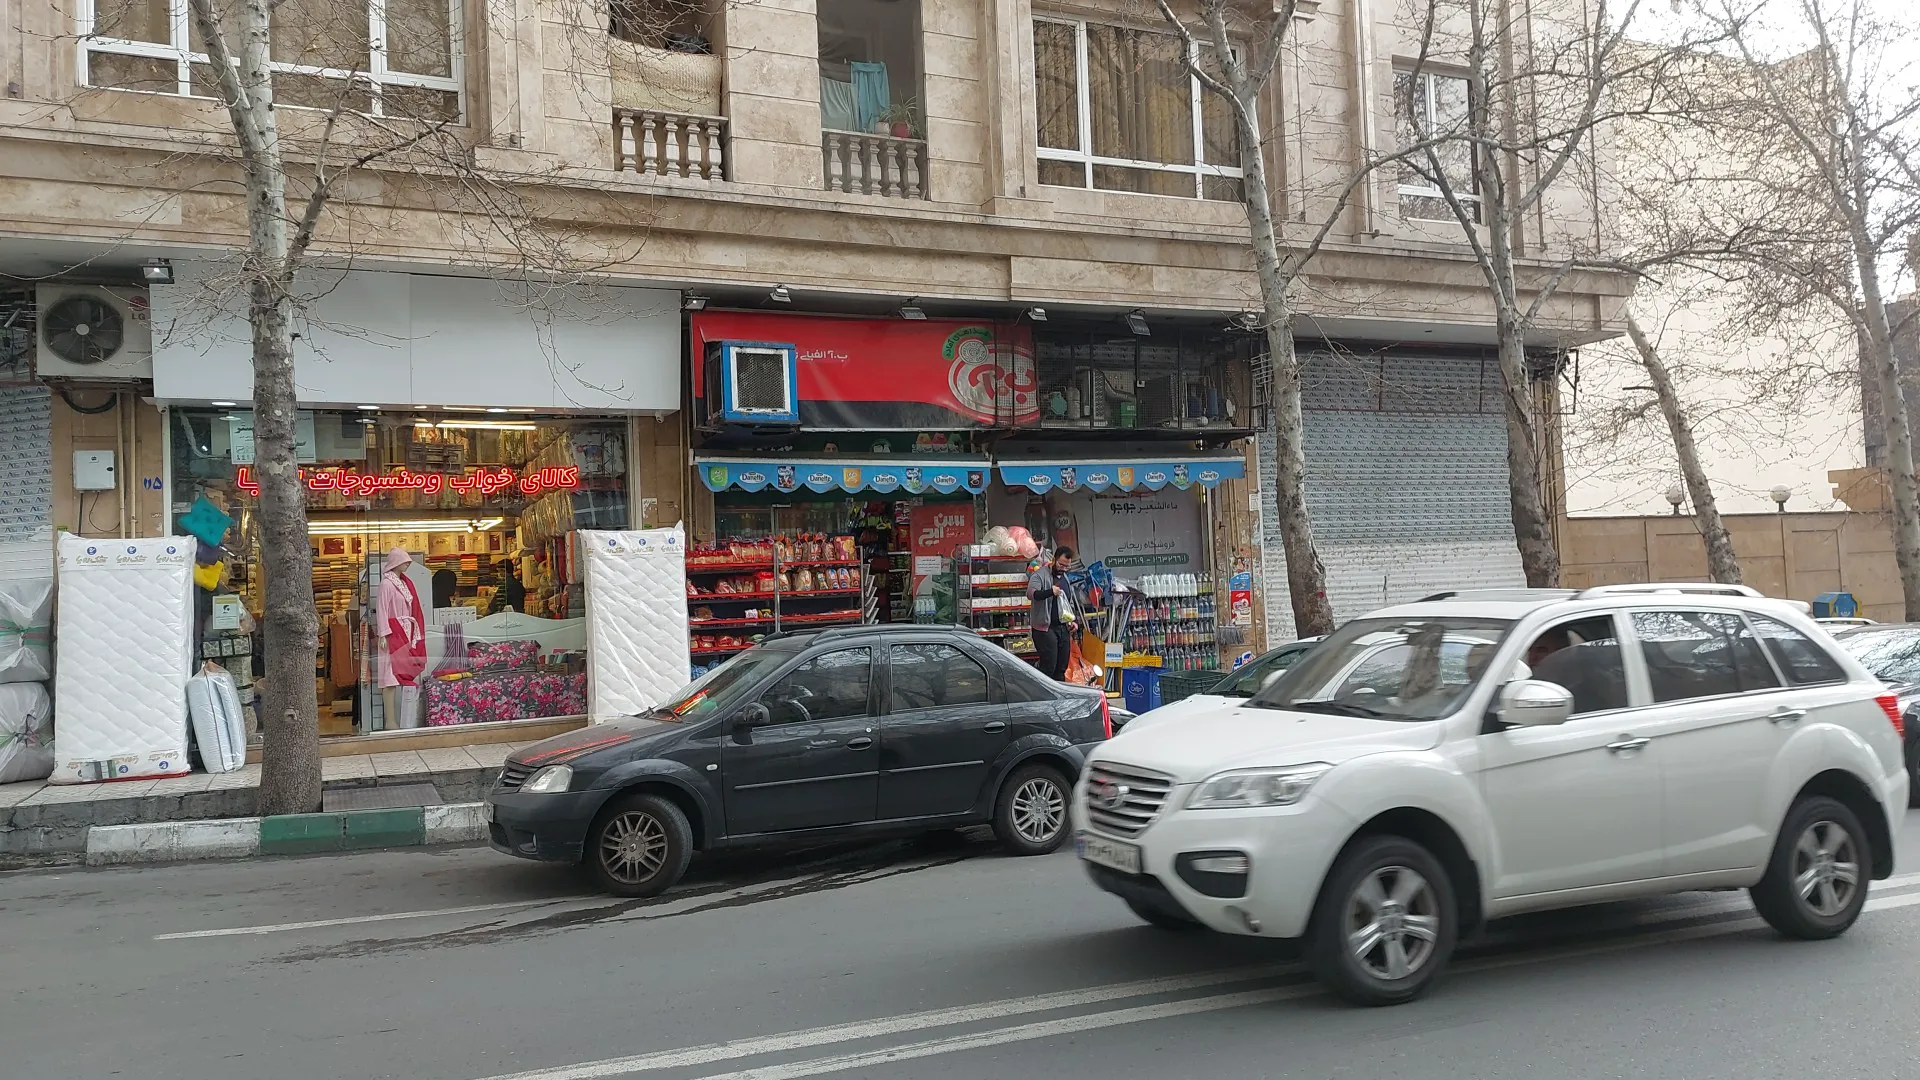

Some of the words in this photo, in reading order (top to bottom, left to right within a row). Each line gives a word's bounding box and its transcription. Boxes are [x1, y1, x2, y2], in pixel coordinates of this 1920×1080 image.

[131, 312, 146, 320] LG
[448, 466, 514, 495] خواب
[519, 466, 578, 495] کالای
[741, 473, 765, 484] Danette
[874, 474, 896, 484] Danette
[1110, 502, 1136, 515] جوجو
[934, 512, 965, 529] سن
[918, 525, 944, 547] ایچ
[1144, 538, 1176, 550] فروشگاه
